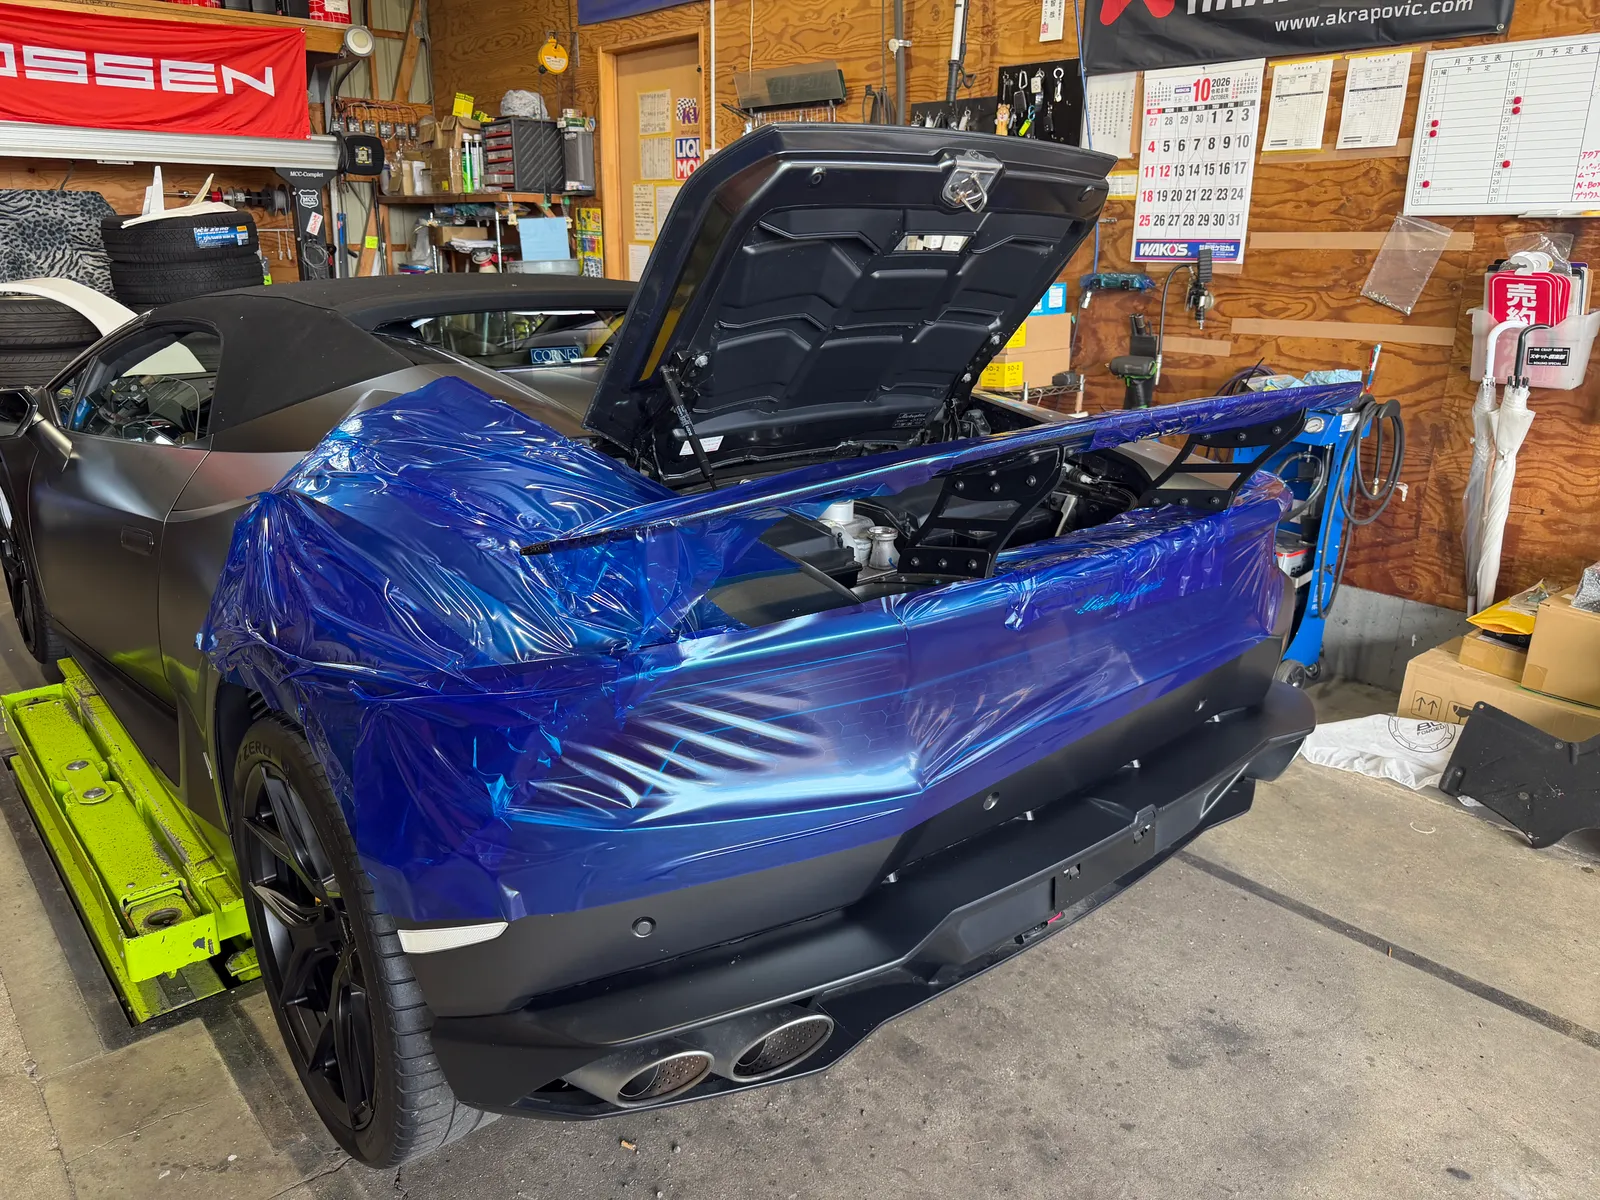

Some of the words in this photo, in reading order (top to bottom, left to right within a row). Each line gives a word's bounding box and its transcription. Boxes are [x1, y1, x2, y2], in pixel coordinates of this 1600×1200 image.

[1275, 0, 1474, 32] www.akrapovic.com
[0, 43, 275, 97] SSEN
[1193, 78, 1211, 102] 10
[1212, 77, 1230, 87] 2026
[1149, 118, 1158, 126] 27
[1165, 117, 1173, 125] 28
[1180, 116, 1188, 124] 29
[1195, 114, 1204, 123] 30
[1212, 111, 1217, 123] 1
[1226, 110, 1234, 122] 2
[1241, 108, 1250, 121] 3
[1148, 141, 1155, 152] 4
[1163, 140, 1170, 152] 5
[1178, 140, 1185, 151] 6
[1194, 139, 1200, 150] 7
[1208, 137, 1215, 150] 8
[1223, 136, 1230, 148] 9
[1237, 135, 1249, 148] 10
[1144, 166, 1155, 178] 11
[1160, 165, 1170, 177] 12
[1174, 165, 1185, 176] 13
[1189, 164, 1200, 176] 14
[1204, 163, 1214, 175] 15
[1219, 162, 1230, 174] 16
[1234, 162, 1246, 174] 17
[1142, 190, 1153, 202] 18
[1157, 190, 1168, 202] 19
[1171, 190, 1182, 201] 20
[1186, 190, 1196, 201] 21
[1200, 189, 1212, 201] 22
[1216, 188, 1228, 200] 23
[1231, 188, 1243, 200] 24
[1139, 215, 1150, 226] 25
[1154, 215, 1165, 226] 26
[1168, 214, 1180, 226] 27
[1183, 214, 1195, 226] 28
[1198, 214, 1210, 226] 29
[1213, 214, 1225, 226] 30
[1228, 214, 1240, 226] 31
[1506, 283, 1537, 325] 売約
[533, 349, 579, 361] CORNES
[243, 740, 272, 761] ZERO
